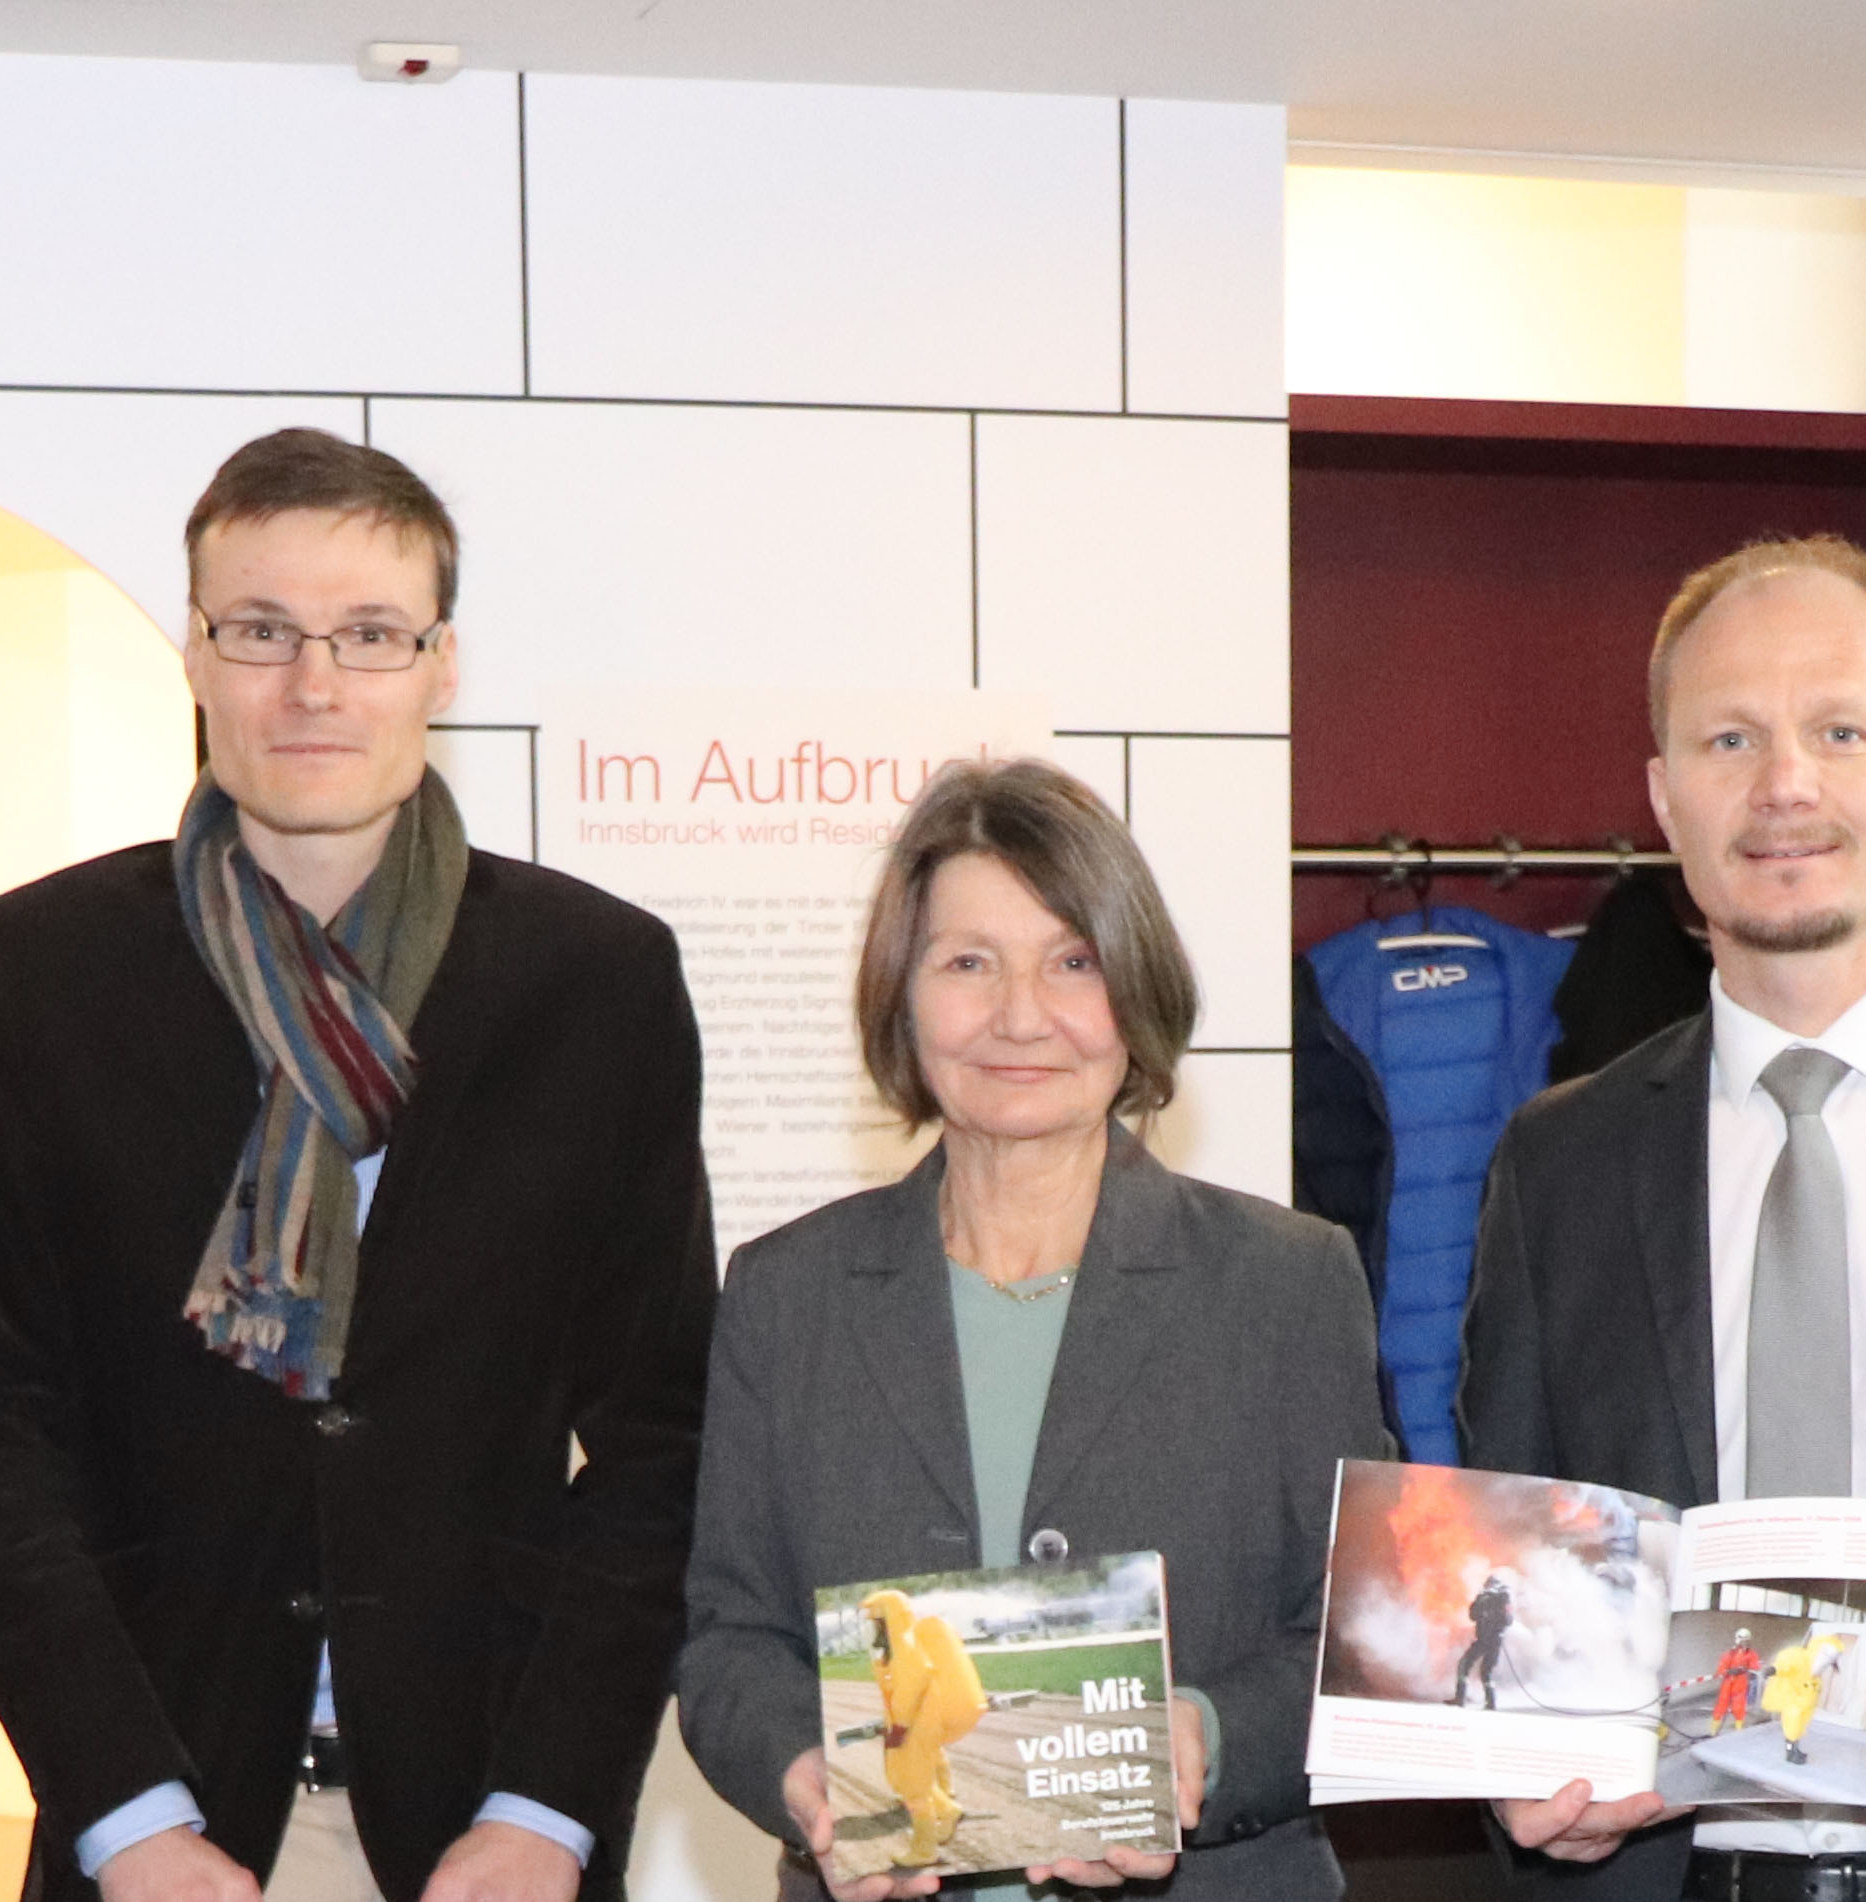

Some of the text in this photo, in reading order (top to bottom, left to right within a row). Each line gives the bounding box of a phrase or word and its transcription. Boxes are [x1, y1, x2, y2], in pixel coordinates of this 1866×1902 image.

[578, 739, 1011, 804] Im Aufbru
[579, 817, 726, 846] Innsbruck
[737, 817, 799, 846] wird
[1391, 964, 1469, 992] CMP
[1082, 1676, 1147, 1714] Mit
[1016, 1724, 1148, 1763] vollem
[1026, 1760, 1153, 1799] Einsatz
